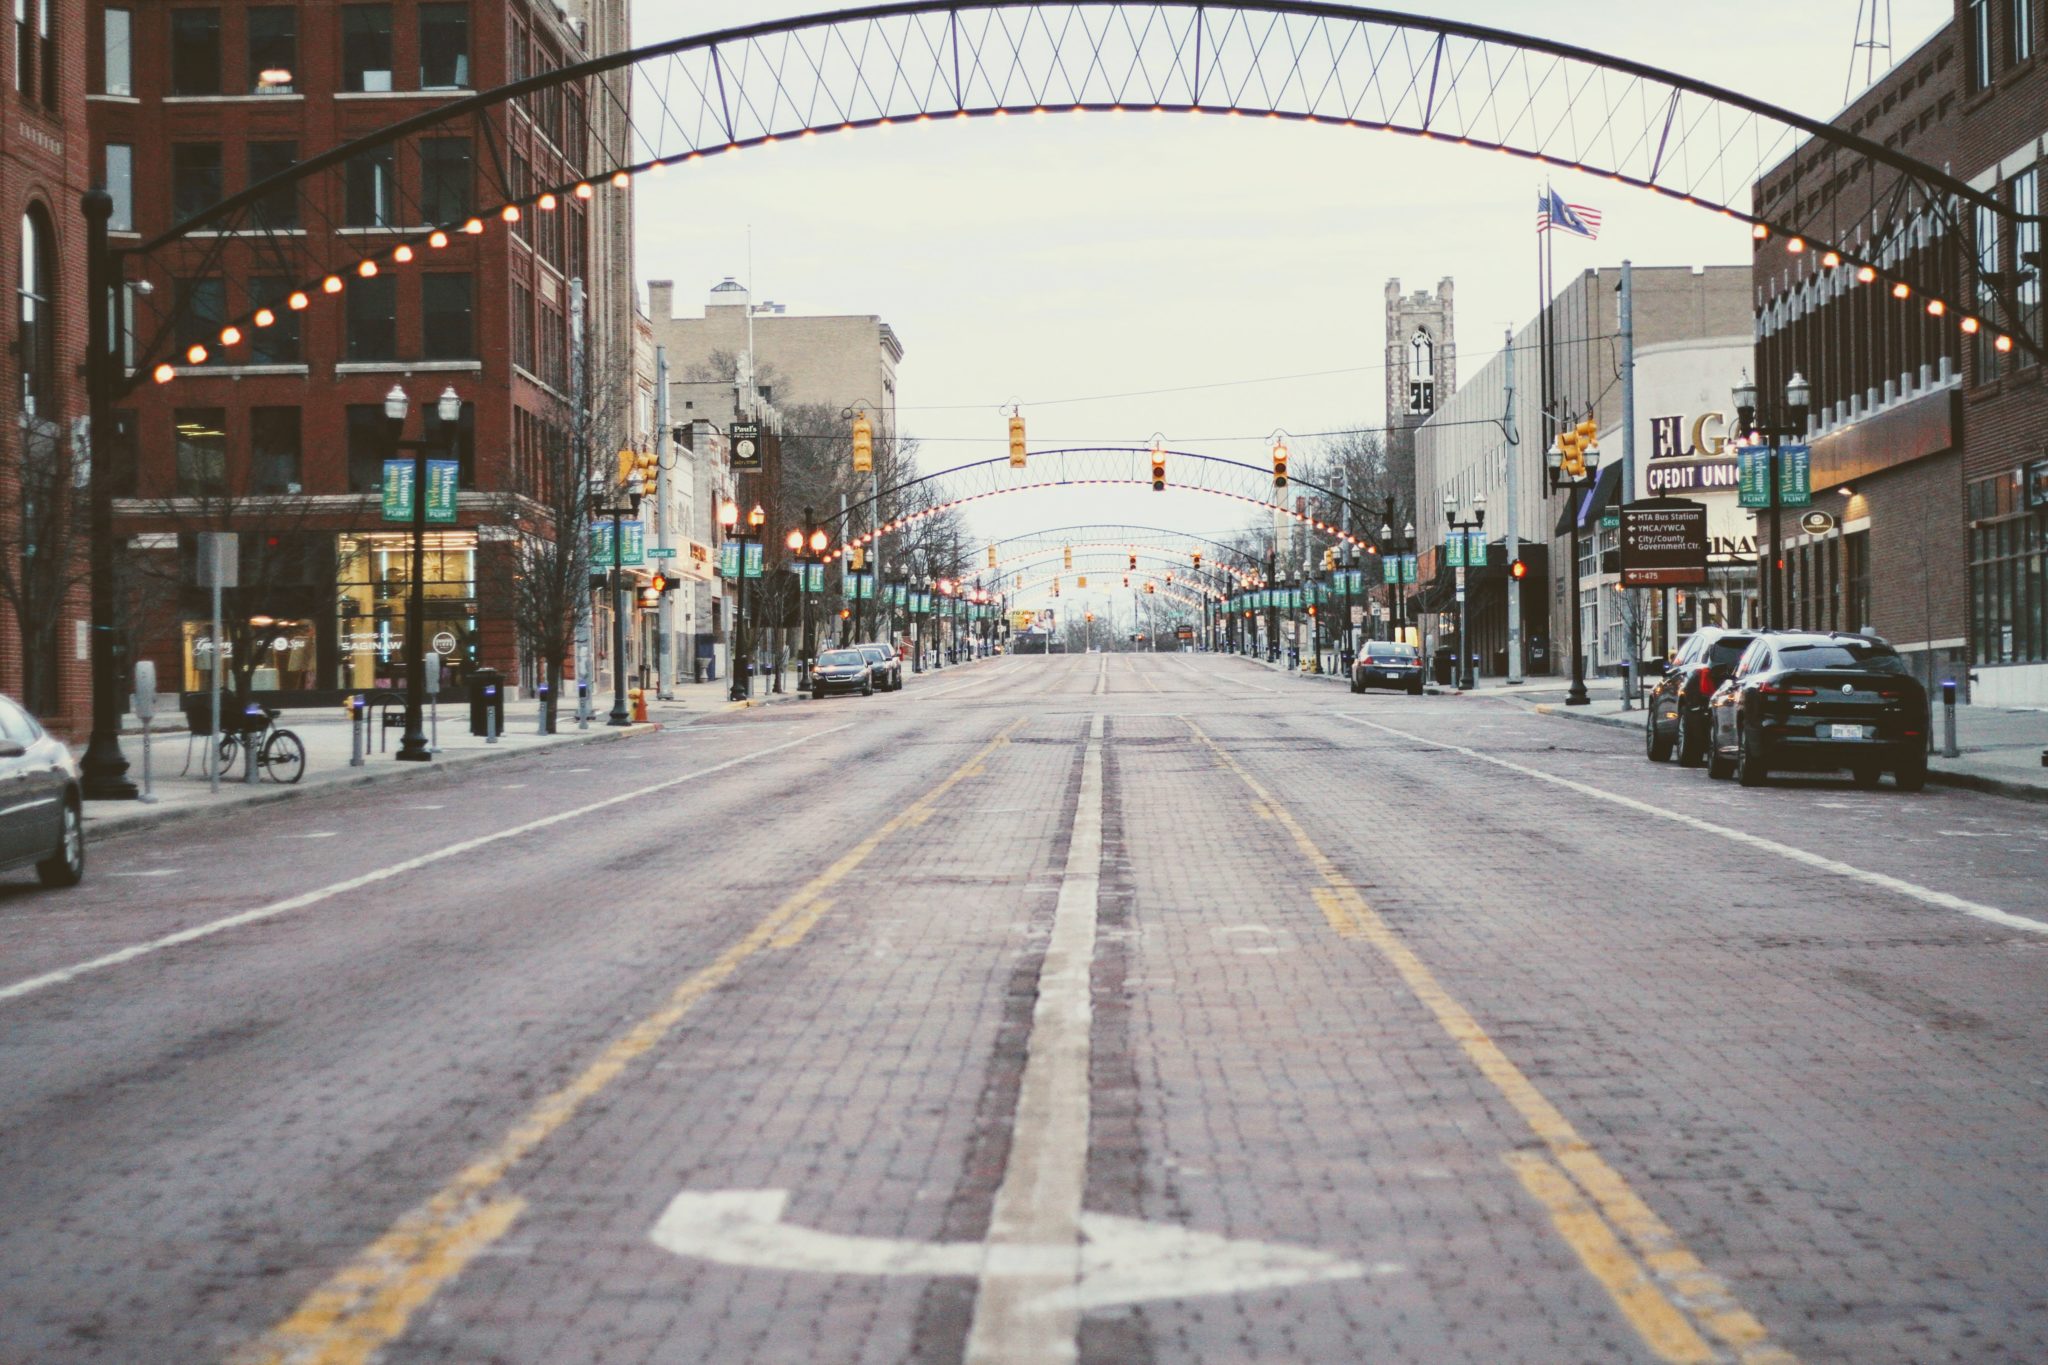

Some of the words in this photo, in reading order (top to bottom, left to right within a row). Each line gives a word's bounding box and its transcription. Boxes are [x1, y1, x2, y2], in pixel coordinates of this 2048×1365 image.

[1650, 412, 1739, 459] ELG
[1650, 467, 1695, 490] CREDIT
[1702, 465, 1739, 486] UNI
[1742, 452, 1753, 492] Welcome
[1755, 452, 1767, 493] Welcome
[1780, 451, 1793, 492] Welcome
[1795, 452, 1807, 492] Welcome
[400, 466, 413, 507] Welcome
[442, 467, 455, 507] Welcome
[1784, 495, 1807, 503] FLINT
[1655, 513, 1669, 521] Bus
[1670, 512, 1699, 521] Station
[1638, 524, 1686, 532] YMCA/YWCA
[1638, 535, 1685, 543] City/County
[1638, 543, 1687, 551] Government
[1706, 536, 1758, 553] INA
[648, 549, 668, 557] Second
[341, 641, 403, 651] SAGINAW
